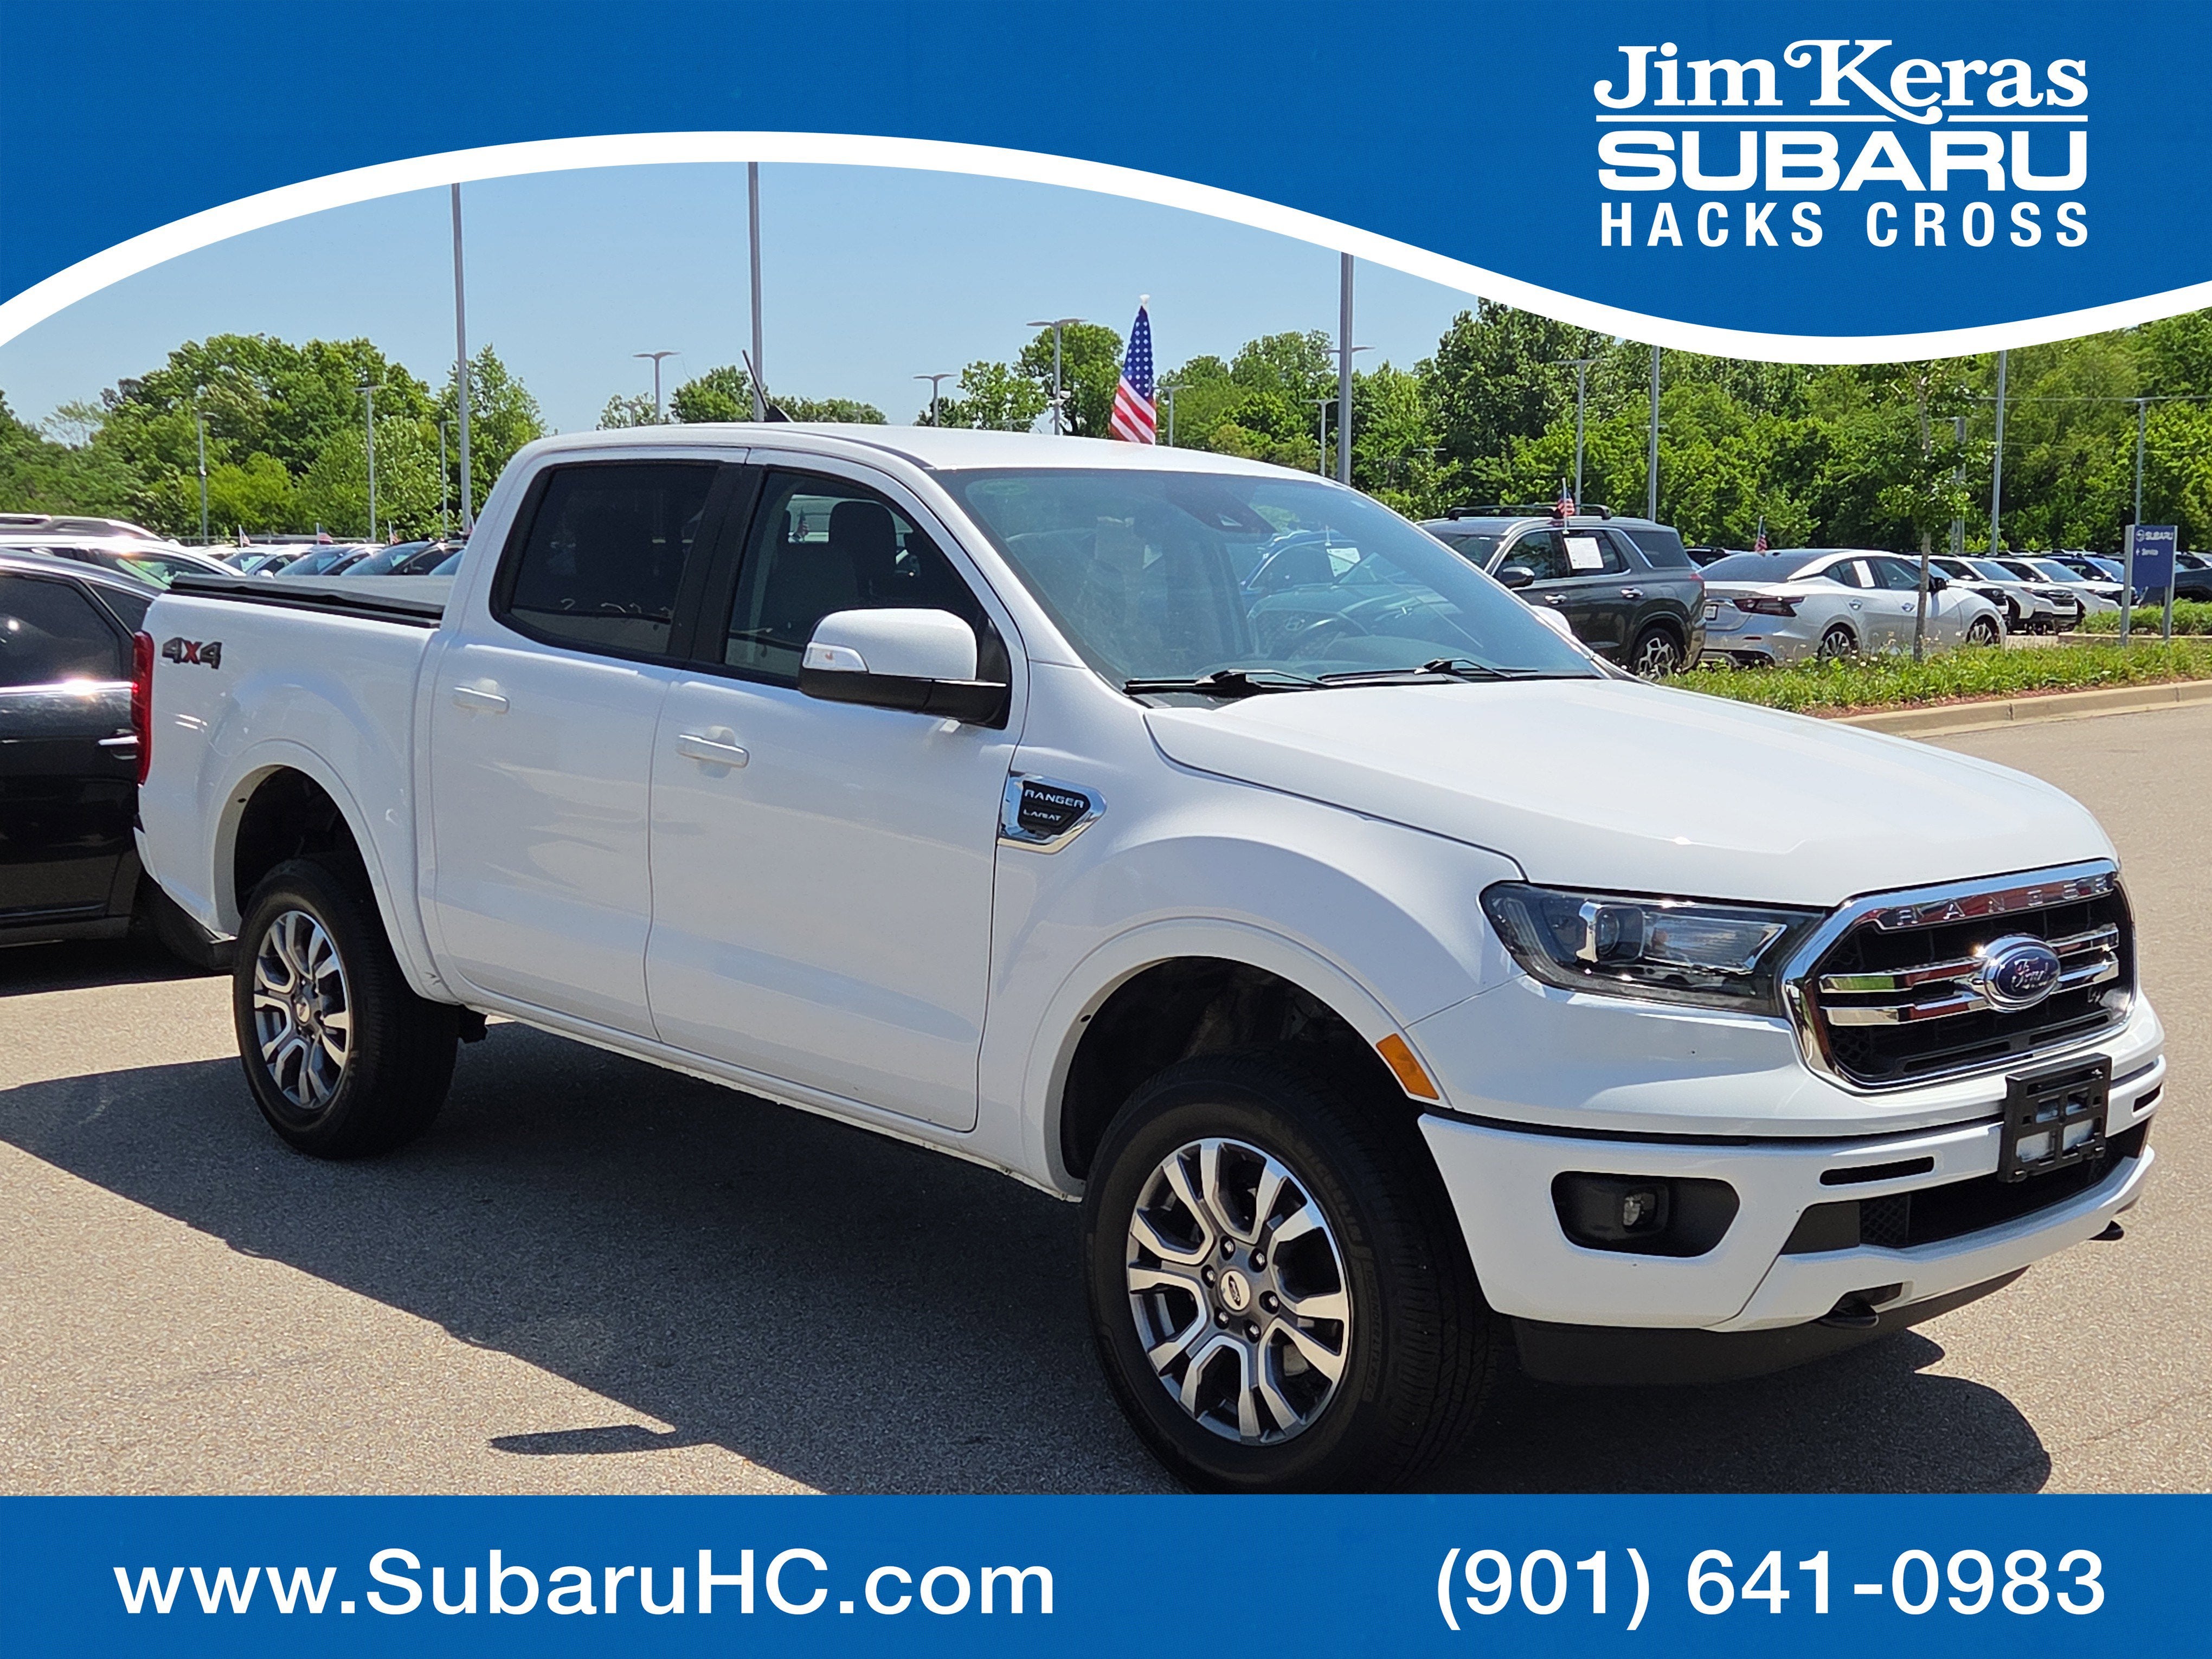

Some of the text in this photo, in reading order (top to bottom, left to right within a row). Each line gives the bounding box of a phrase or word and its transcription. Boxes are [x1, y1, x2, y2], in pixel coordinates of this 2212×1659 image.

[1025, 789, 1084, 808] RANGER
[1023, 809, 1062, 821] LARIAT
[2011, 956, 2049, 992] Ford
